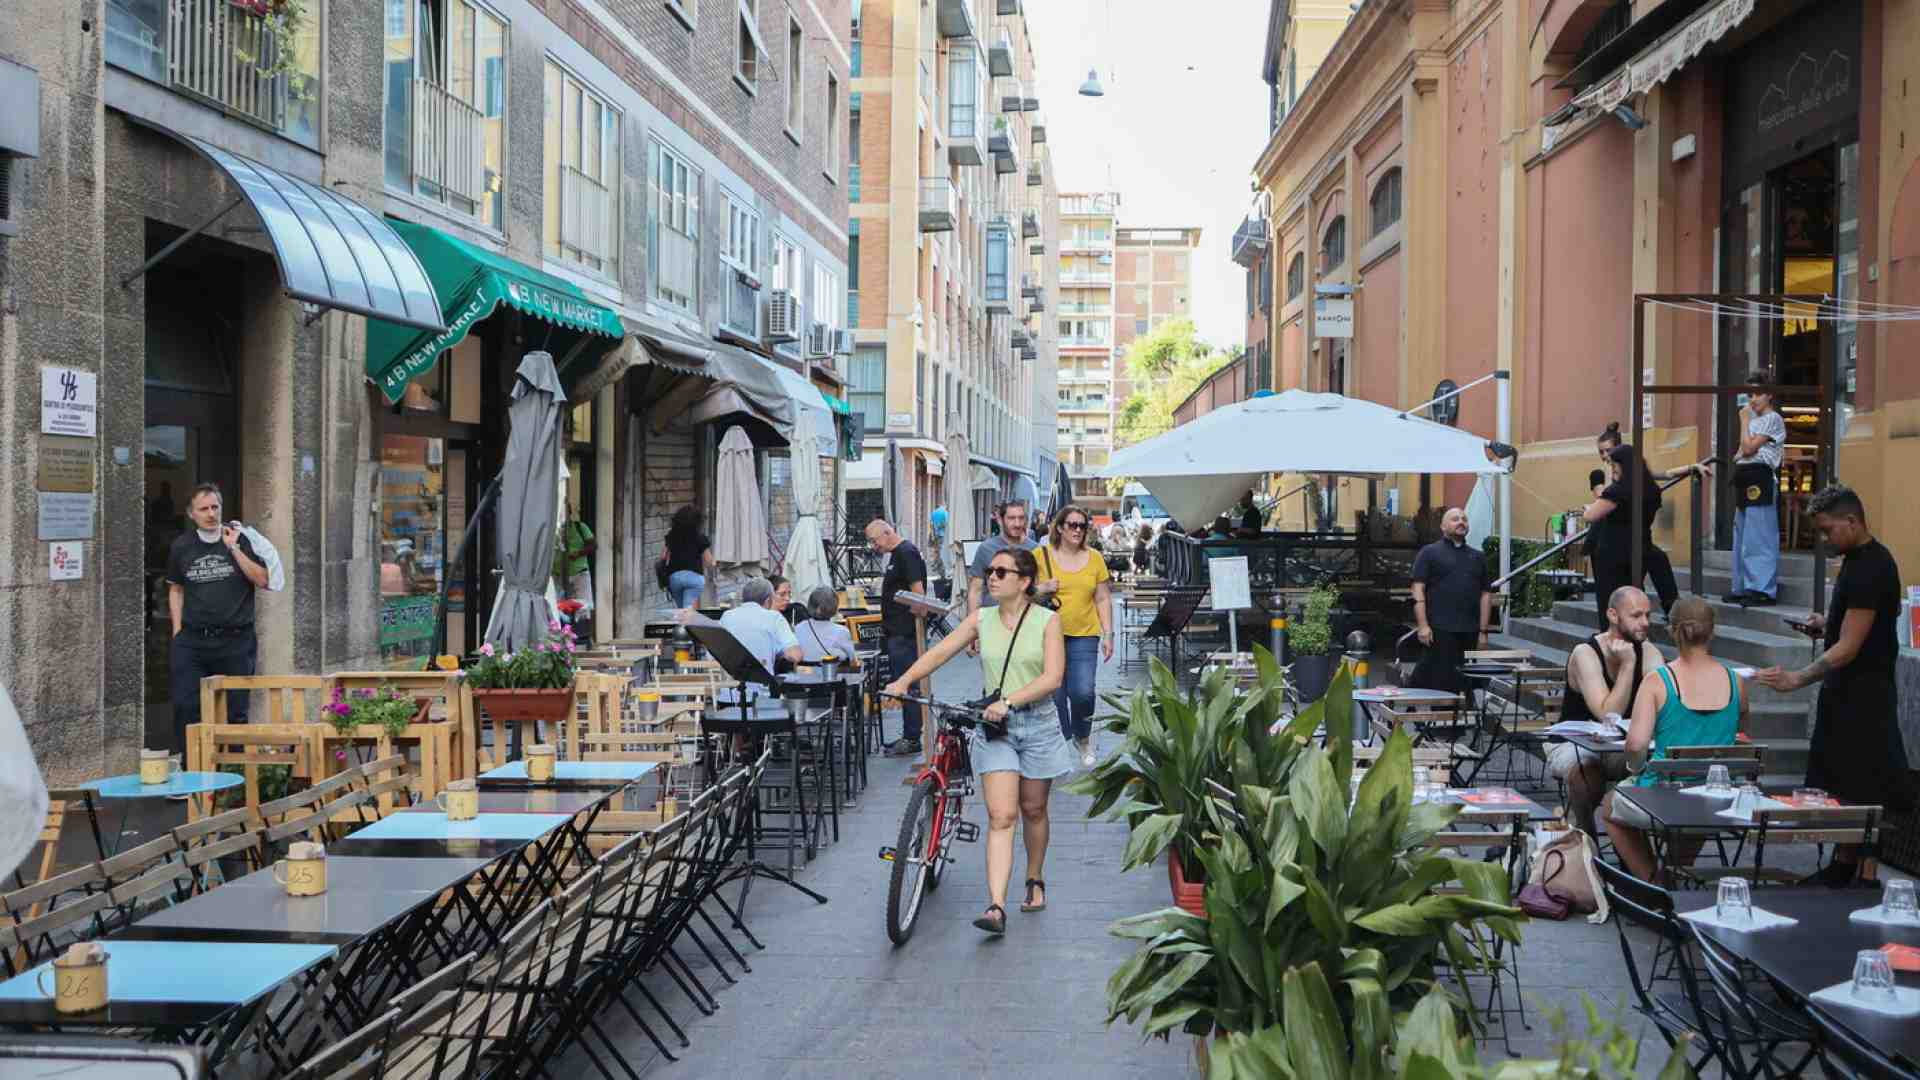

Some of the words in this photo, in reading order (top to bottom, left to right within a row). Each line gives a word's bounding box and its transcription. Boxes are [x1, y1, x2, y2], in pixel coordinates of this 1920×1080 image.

[533, 289, 561, 314] NEW
[562, 300, 603, 326] MARKET
[404, 341, 437, 371] NEW
[291, 866, 313, 884] 25
[62, 975, 89, 999] 26
